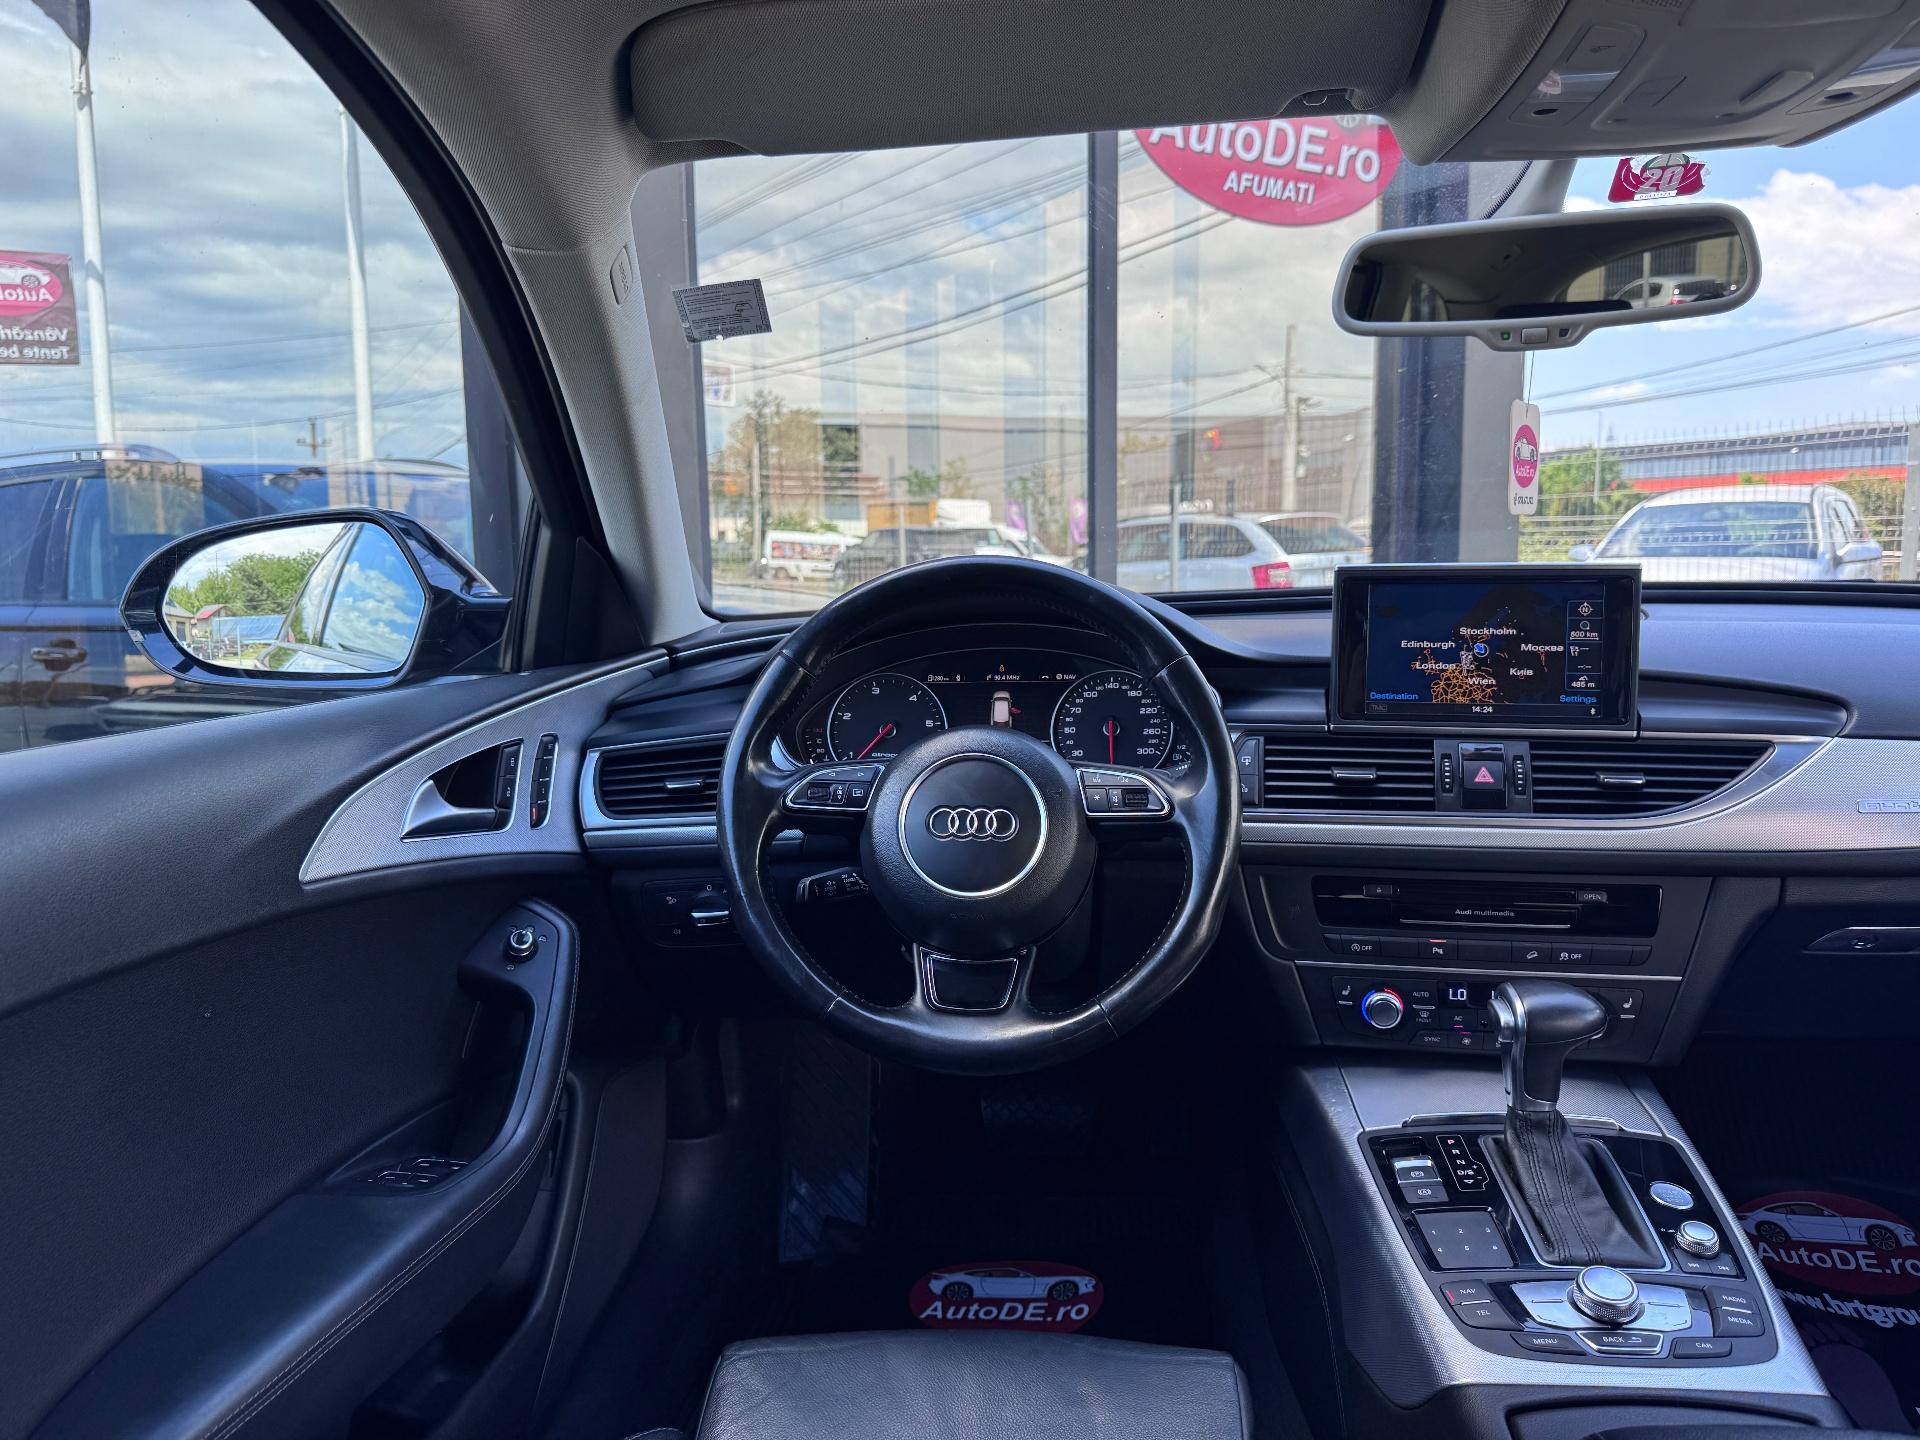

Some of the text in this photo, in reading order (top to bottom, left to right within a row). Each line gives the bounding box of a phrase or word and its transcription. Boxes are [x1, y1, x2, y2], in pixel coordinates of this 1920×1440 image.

[1223, 170, 1315, 205] AFUMATI
[1459, 626, 1517, 635] Stockholm
[1400, 640, 1456, 650] Edinburgh
[1520, 644, 1564, 652] Москва
[1416, 662, 1456, 670] London
[1468, 677, 1497, 685] Wien
[1370, 692, 1419, 700] Destination
[1560, 694, 1597, 704] Settings
[1449, 988, 1467, 1000] LO
[1756, 1241, 1920, 1276] AutoDE.ro
[1722, 1295, 1747, 1304] RADIO
[920, 1300, 1090, 1322] AutoDE.ro
[1727, 1316, 1753, 1326] MEDIA
